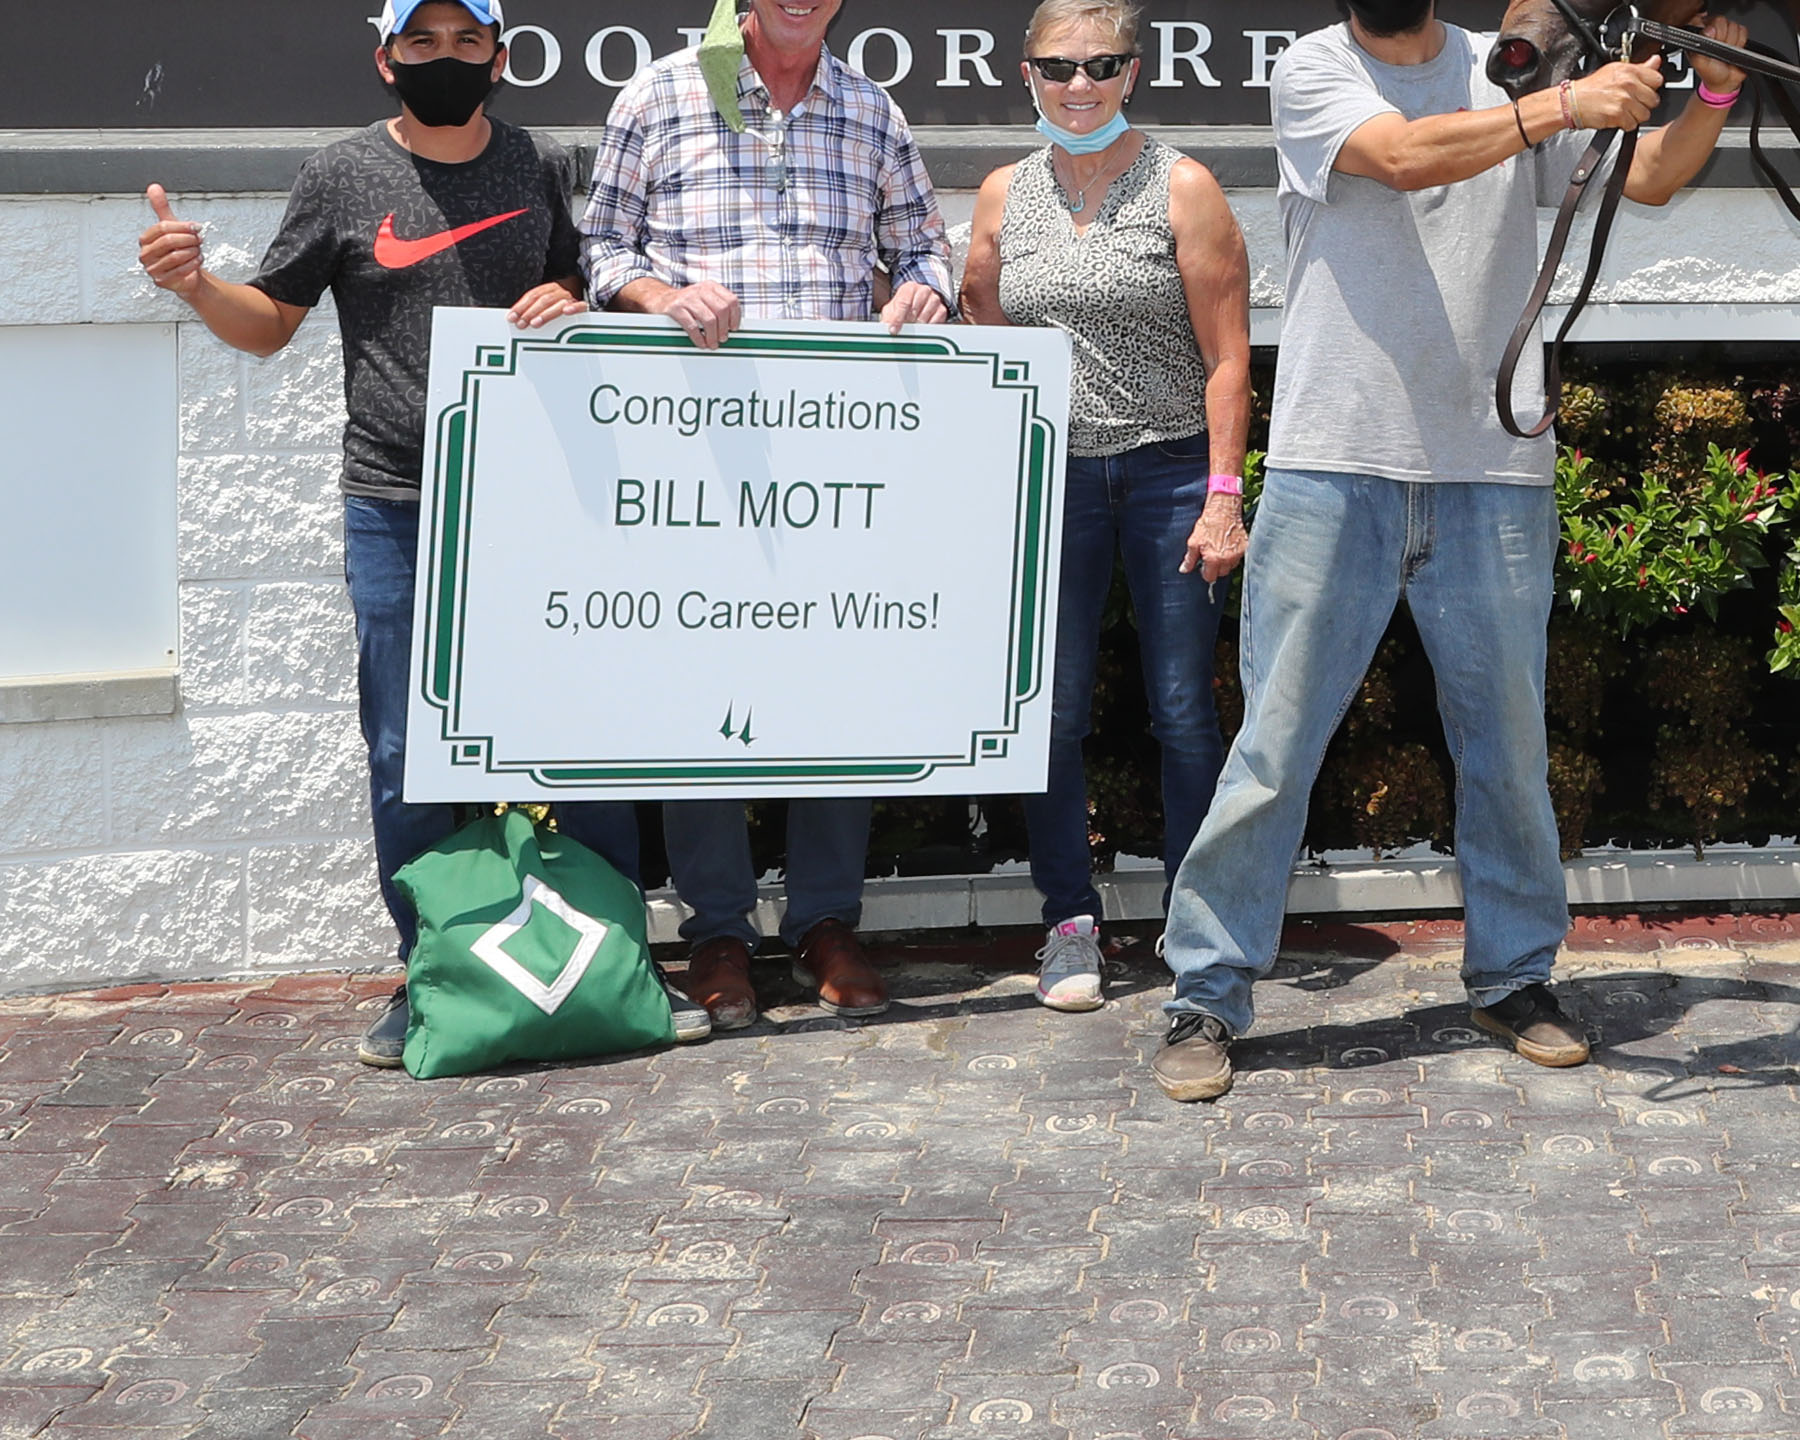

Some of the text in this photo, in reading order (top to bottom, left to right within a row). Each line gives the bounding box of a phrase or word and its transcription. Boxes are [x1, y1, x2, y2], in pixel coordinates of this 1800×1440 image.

[589, 383, 920, 437] Congratulations
[614, 478, 886, 530] BILL MOTT
[545, 590, 940, 636] 5,000 Career Wins!
